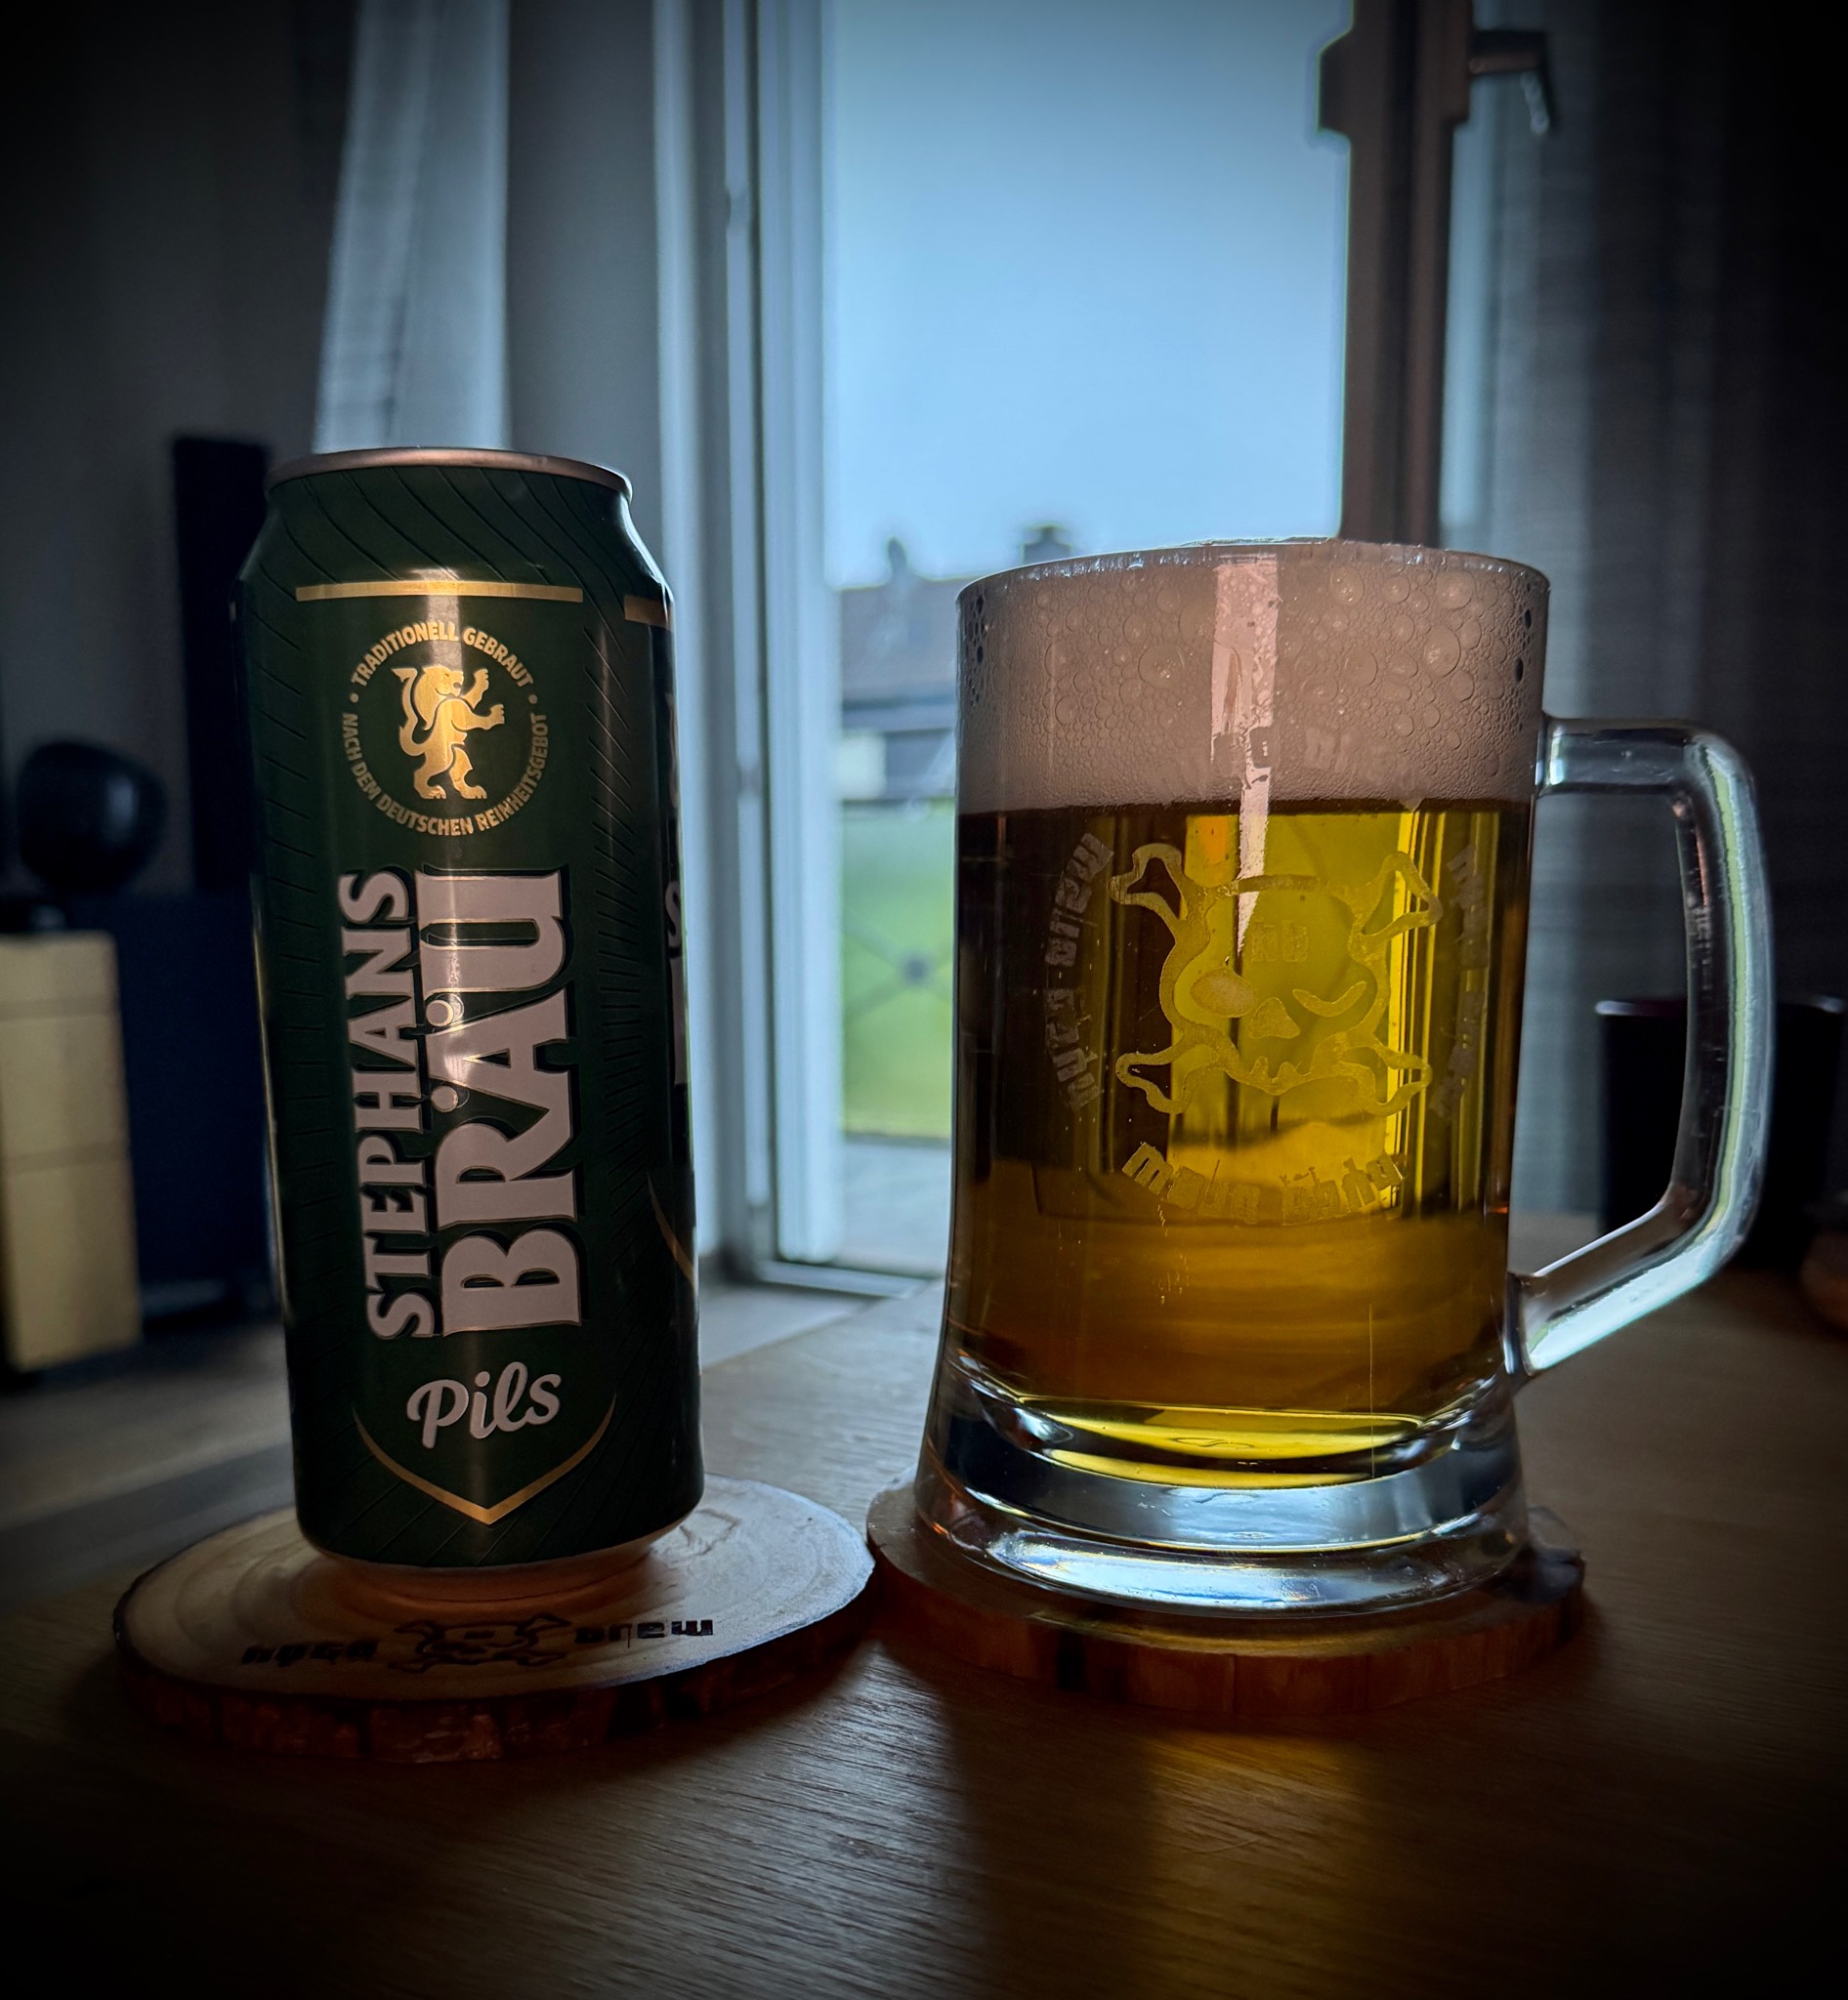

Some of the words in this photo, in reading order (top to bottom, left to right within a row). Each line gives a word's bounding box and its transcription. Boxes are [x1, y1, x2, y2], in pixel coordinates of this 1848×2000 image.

[351, 620, 459, 687] TRADITIONELL
[462, 627, 533, 688] GEBRAUT
[342, 712, 363, 762] NACH
[476, 712, 549, 832] REINHEITSGEBOT
[351, 763, 382, 802] DEM
[375, 799, 474, 837] DEUTSCHEN
[337, 868, 440, 1341] STEPHANS
[415, 867, 584, 1336] BRÄU
[405, 1360, 563, 1449] Pils
